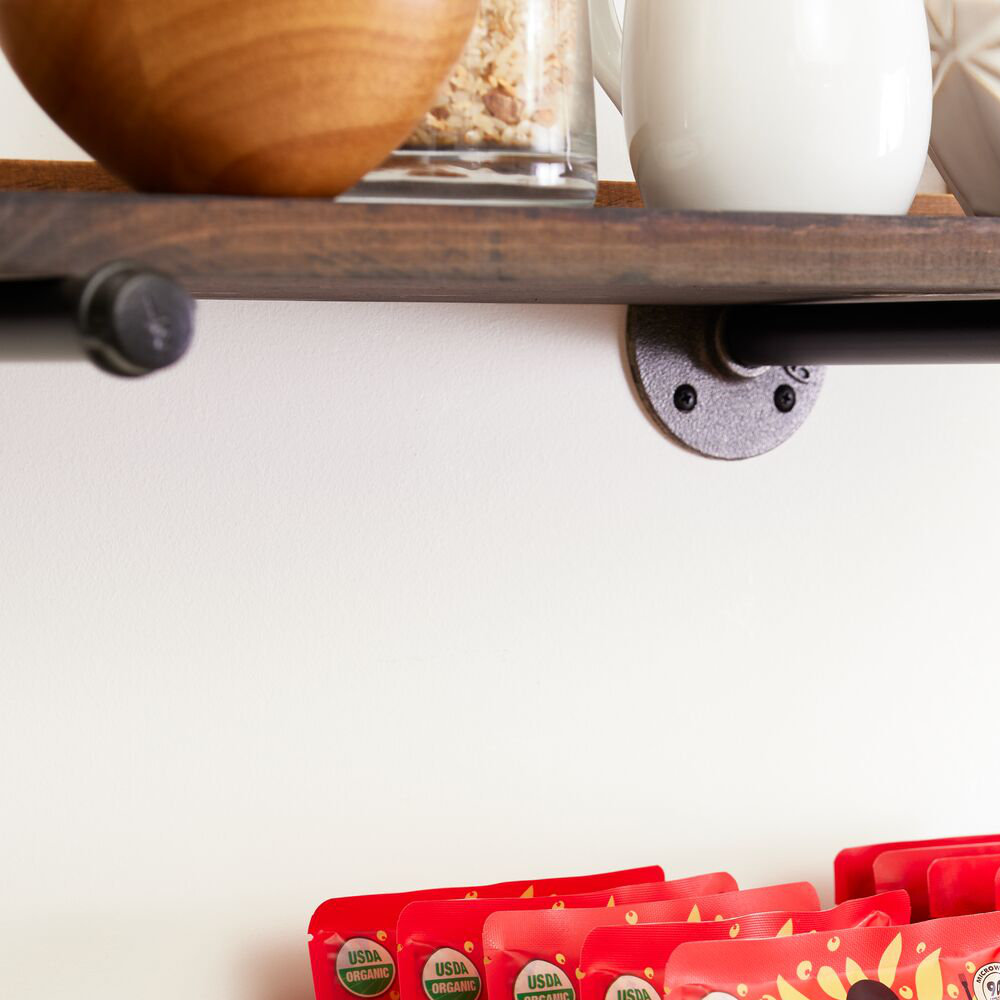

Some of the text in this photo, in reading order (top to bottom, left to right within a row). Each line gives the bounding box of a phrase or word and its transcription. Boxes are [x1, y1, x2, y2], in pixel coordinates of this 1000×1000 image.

[348, 949, 382, 965] USDA
[345, 967, 391, 982] ORGANIC
[435, 961, 469, 977] USDA
[431, 979, 477, 994] ORGANIC
[527, 973, 563, 990] USDA
[987, 979, 1000, 997] 90
